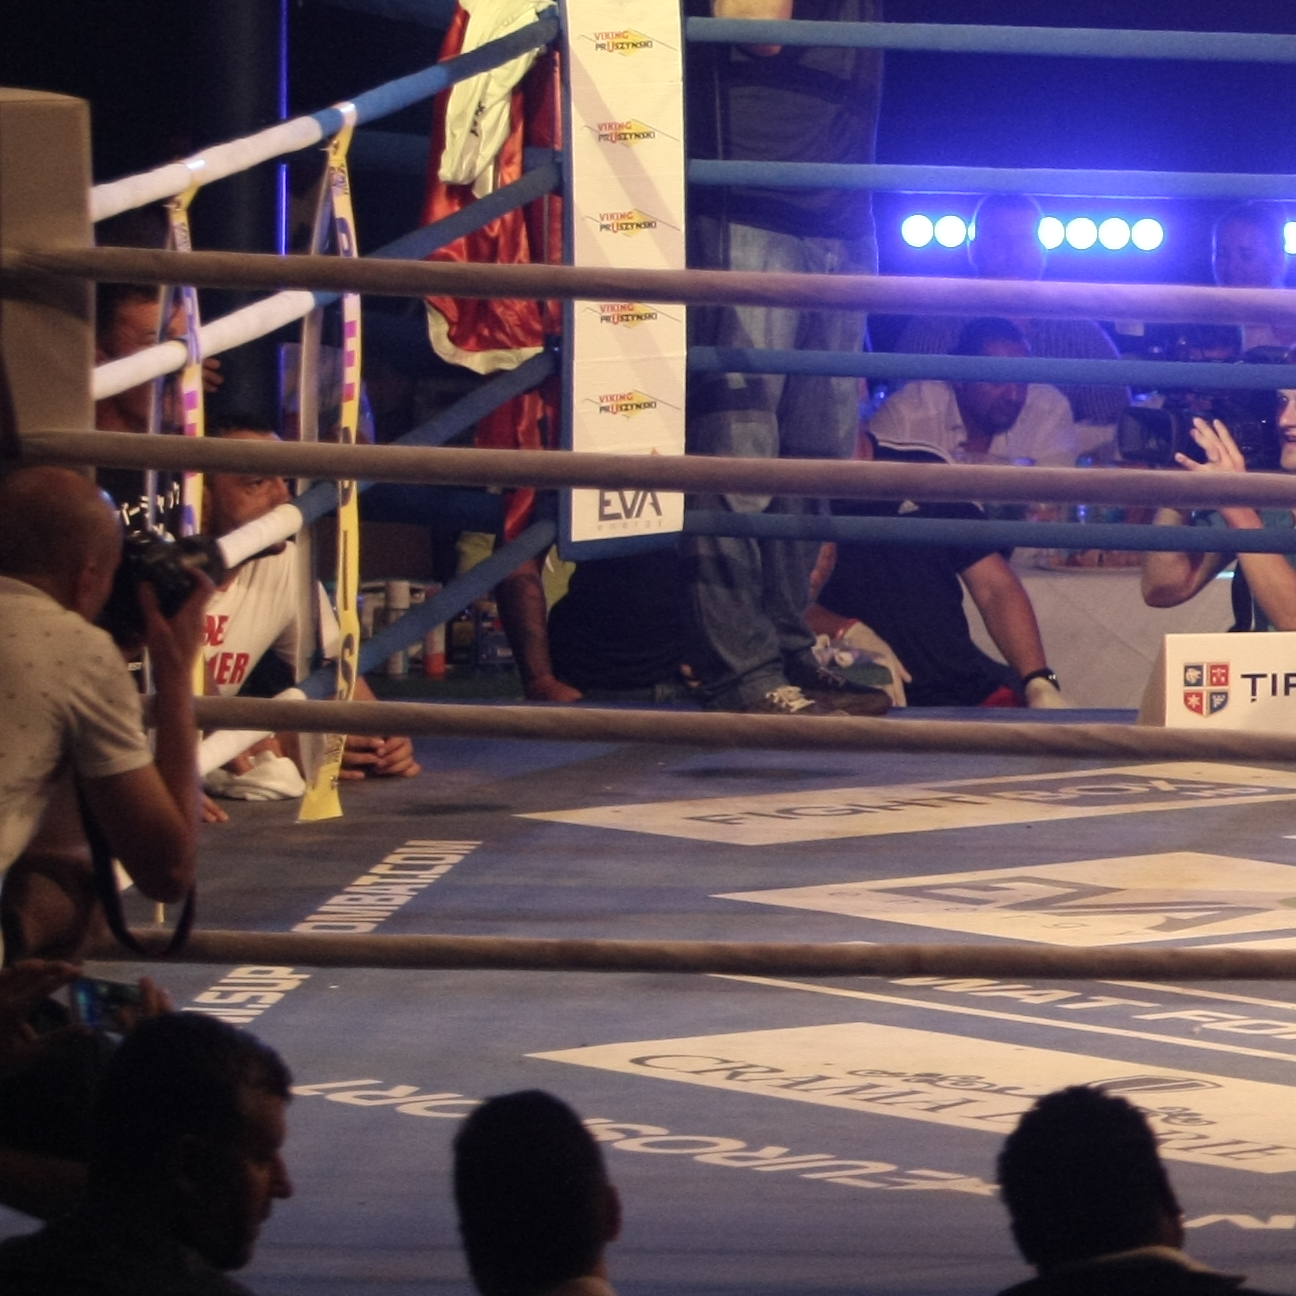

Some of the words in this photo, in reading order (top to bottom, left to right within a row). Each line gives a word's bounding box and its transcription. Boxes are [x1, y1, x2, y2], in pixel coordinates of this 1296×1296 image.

[594, 31, 629, 40] VIKING
[598, 121, 632, 130] VIKING
[599, 211, 634, 221] VIKING
[600, 303, 634, 313] VIKING
[599, 392, 634, 404] VIKING
[599, 490, 662, 521] EVA
[684, 796, 989, 825] FIGHT
[991, 780, 1215, 801] BOX
[868, 976, 1164, 1011] WAT
[628, 1054, 987, 1114] CRAMA
